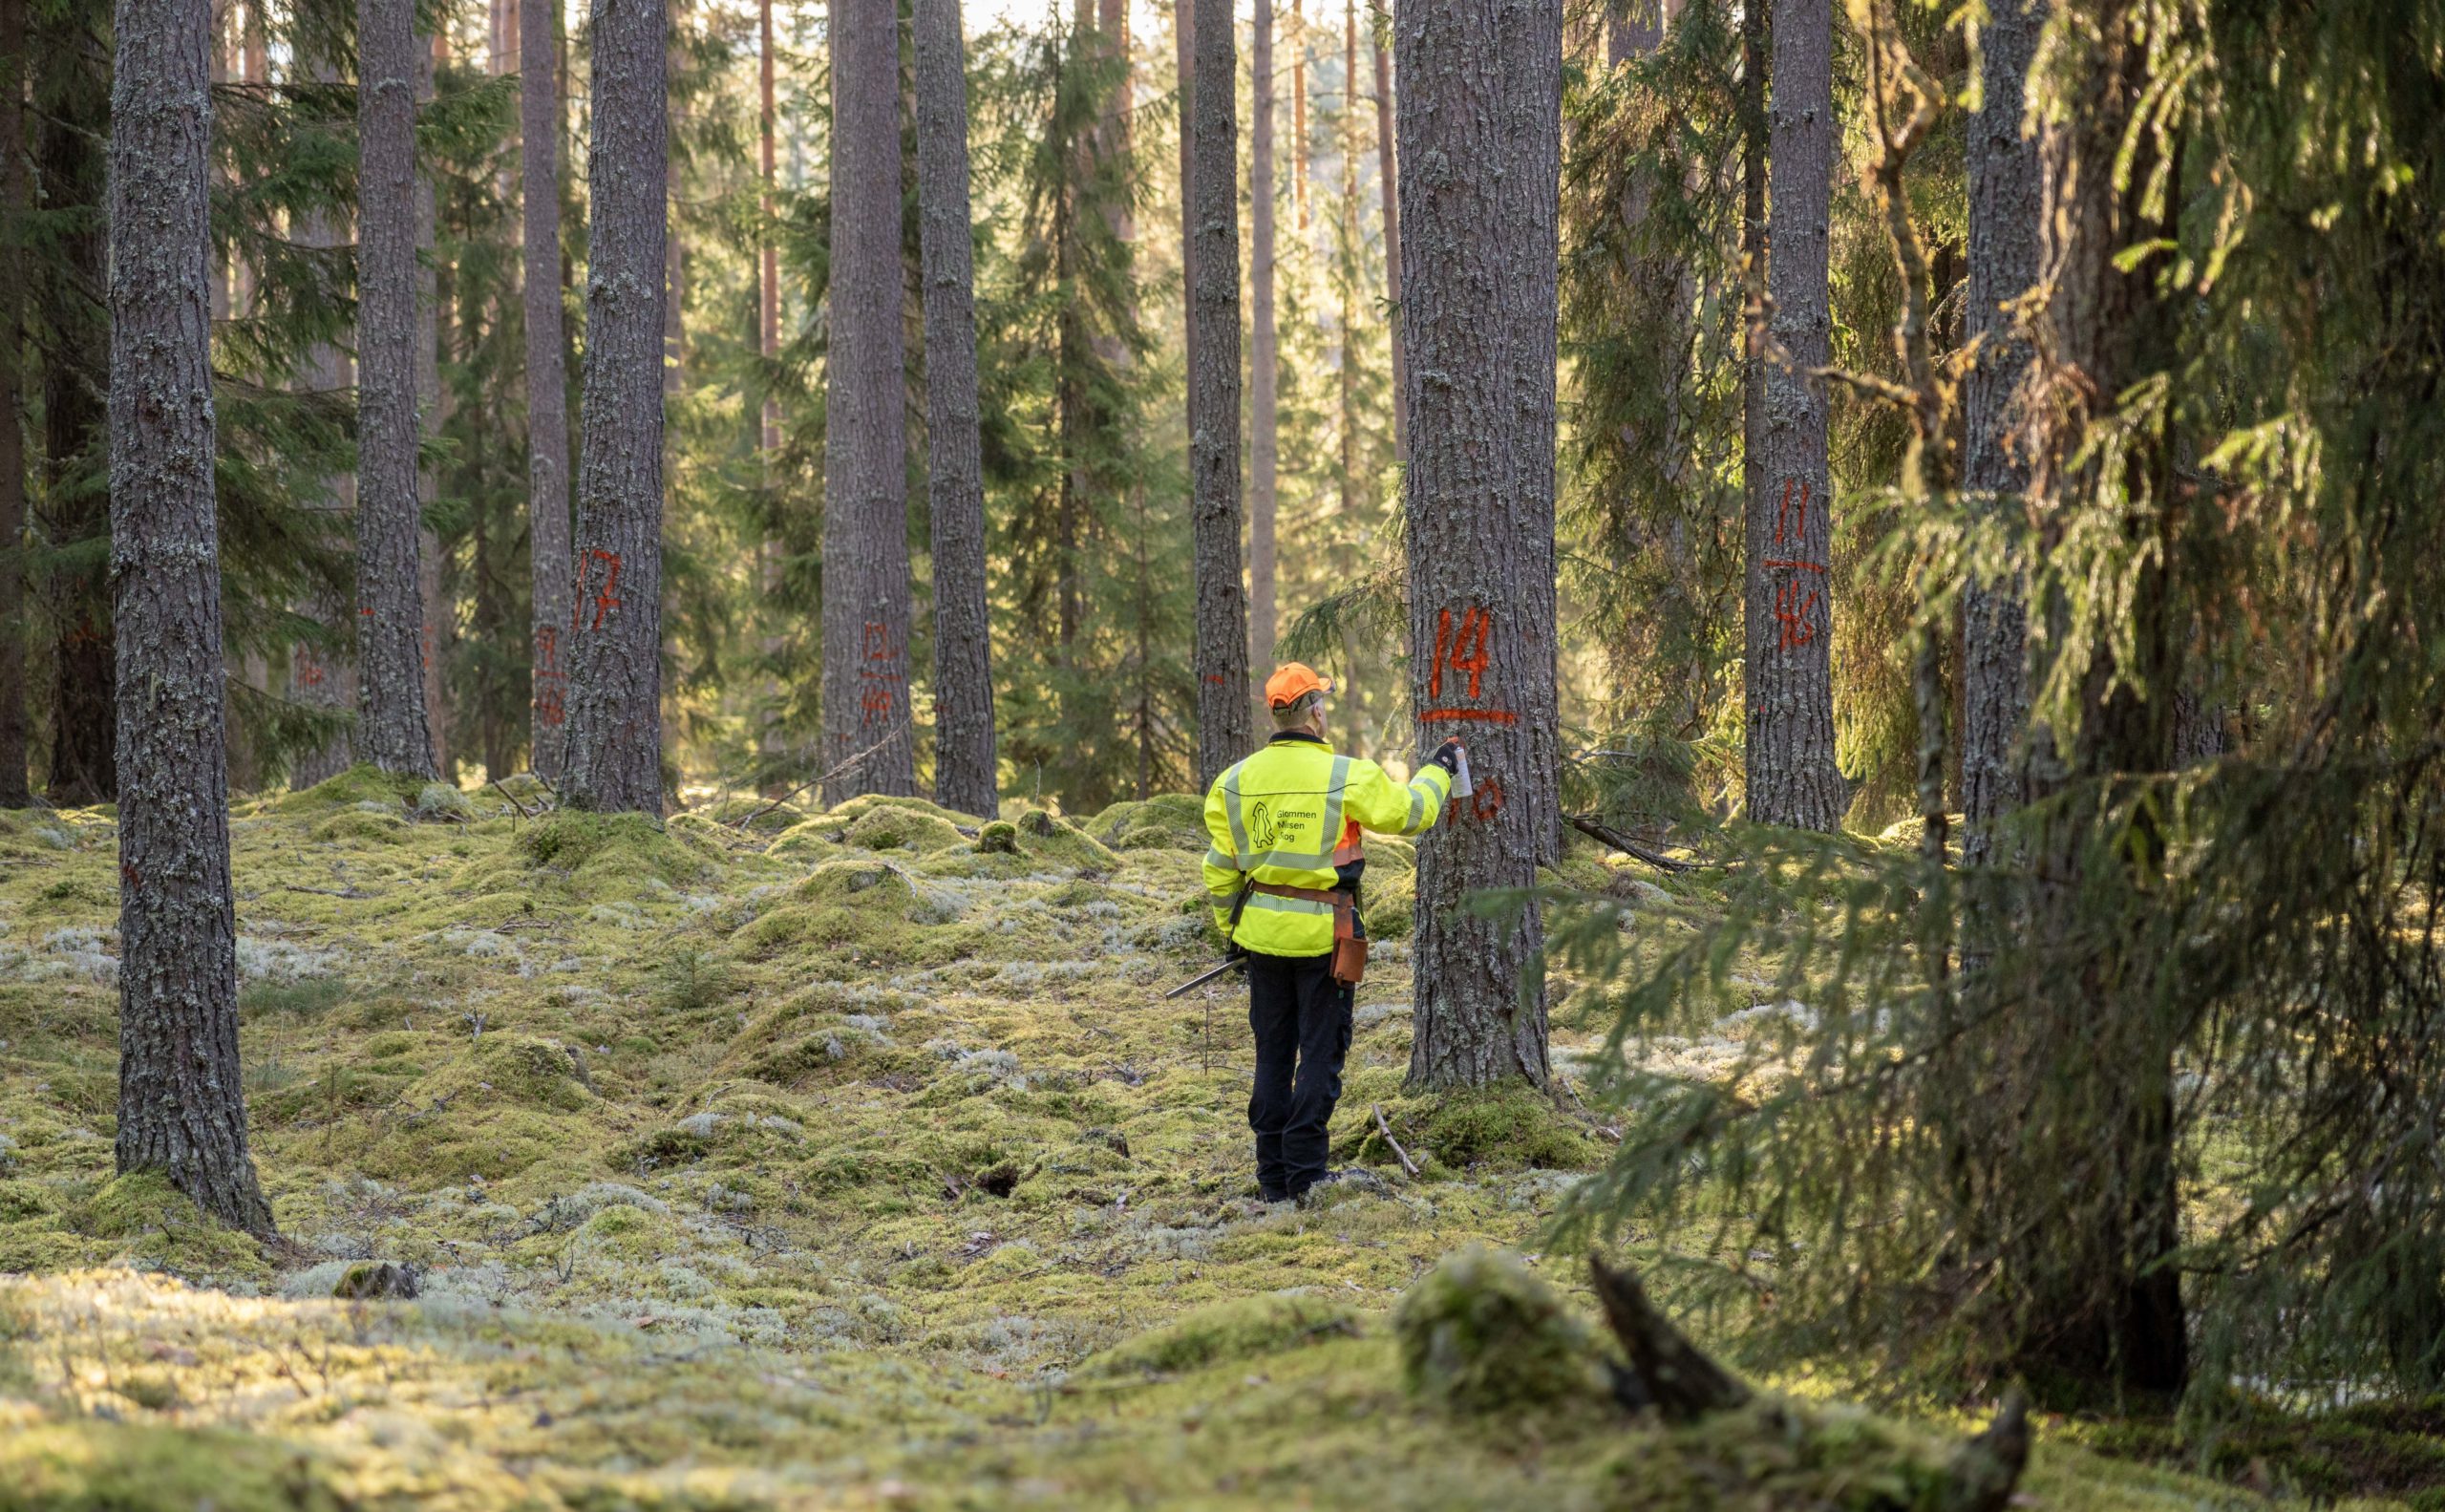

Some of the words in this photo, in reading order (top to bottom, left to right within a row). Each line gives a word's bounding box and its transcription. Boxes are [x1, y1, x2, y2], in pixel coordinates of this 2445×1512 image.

[574, 548, 622, 633] 17
[1430, 606, 1490, 699] 14
[1277, 810, 1317, 819] Glommen
[1278, 831, 1295, 842] og
